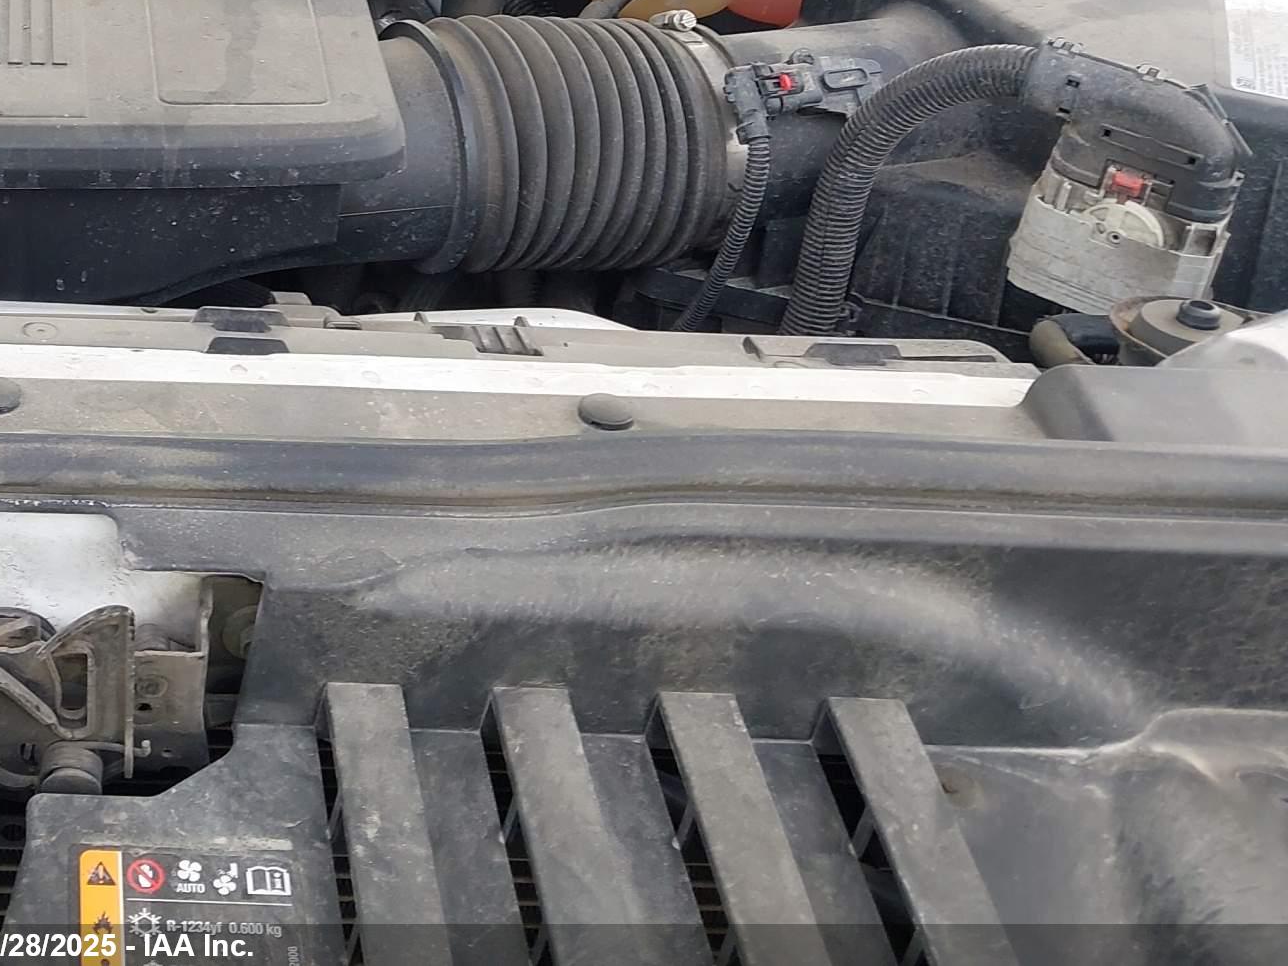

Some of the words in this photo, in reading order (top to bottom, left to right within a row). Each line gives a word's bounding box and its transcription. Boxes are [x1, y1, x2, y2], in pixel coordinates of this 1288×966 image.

[176, 883, 205, 893] AUTO
[166, 920, 222, 934] R-1234yf
[230, 922, 263, 934] 0.600
[266, 923, 282, 938] kg
